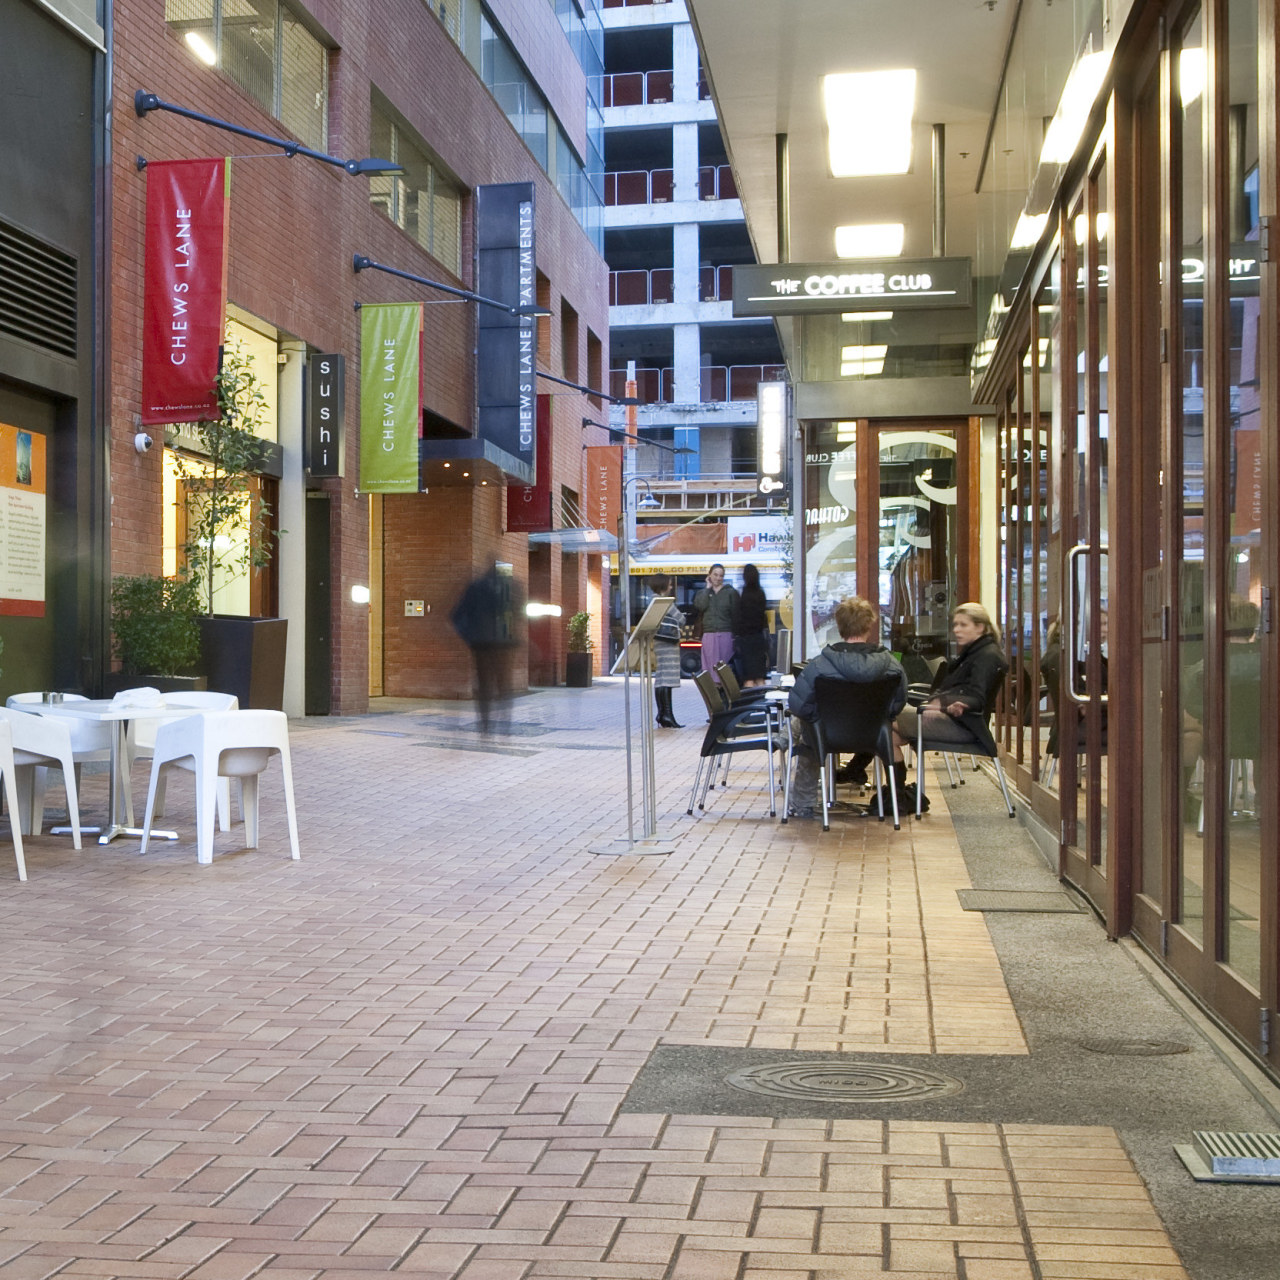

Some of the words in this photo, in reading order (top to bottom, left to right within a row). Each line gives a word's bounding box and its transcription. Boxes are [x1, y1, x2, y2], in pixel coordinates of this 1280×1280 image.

[175, 208, 191, 268] LANE
[770, 278, 802, 295] THE
[804, 273, 885, 296] COFFEE
[888, 273, 932, 291] CLUB
[170, 281, 189, 366] CHEWS
[383, 337, 396, 382] LANE
[520, 330, 532, 375] LANE
[320, 360, 331, 466] sushi
[382, 391, 395, 452] CHEWS
[520, 383, 532, 446] CHEWS
[599, 465, 608, 491] LANE
[599, 496, 608, 530] CHEWS
